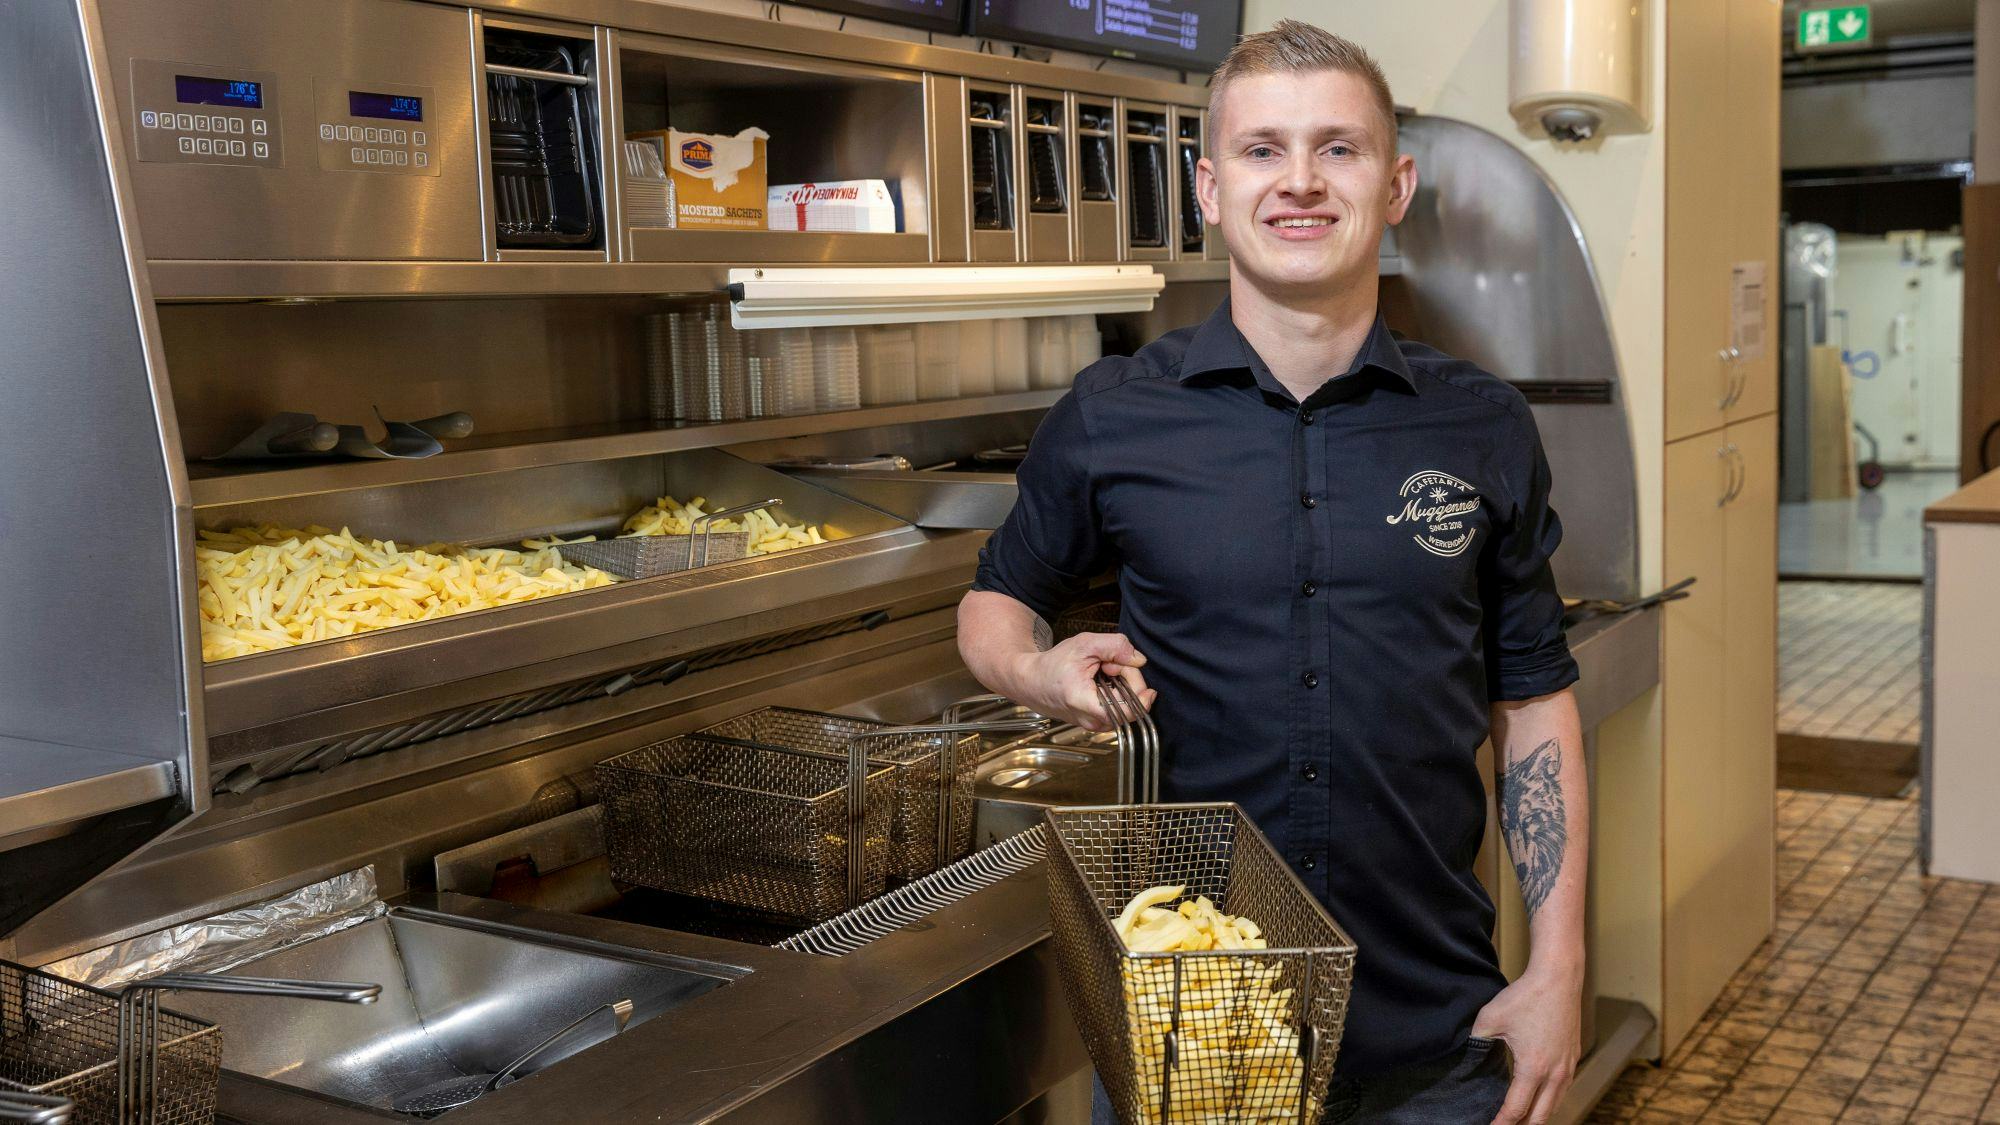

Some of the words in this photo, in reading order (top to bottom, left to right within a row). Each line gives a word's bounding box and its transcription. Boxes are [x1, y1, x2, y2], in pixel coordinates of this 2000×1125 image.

[679, 204, 725, 217] MOSTERD
[726, 207, 762, 219] SACHETS
[1410, 477, 1466, 494] CAFETARIA
[1429, 523, 1449, 532] SINCE
[1449, 521, 1463, 530] 2018
[1429, 534, 1466, 549] WERKENDAM
